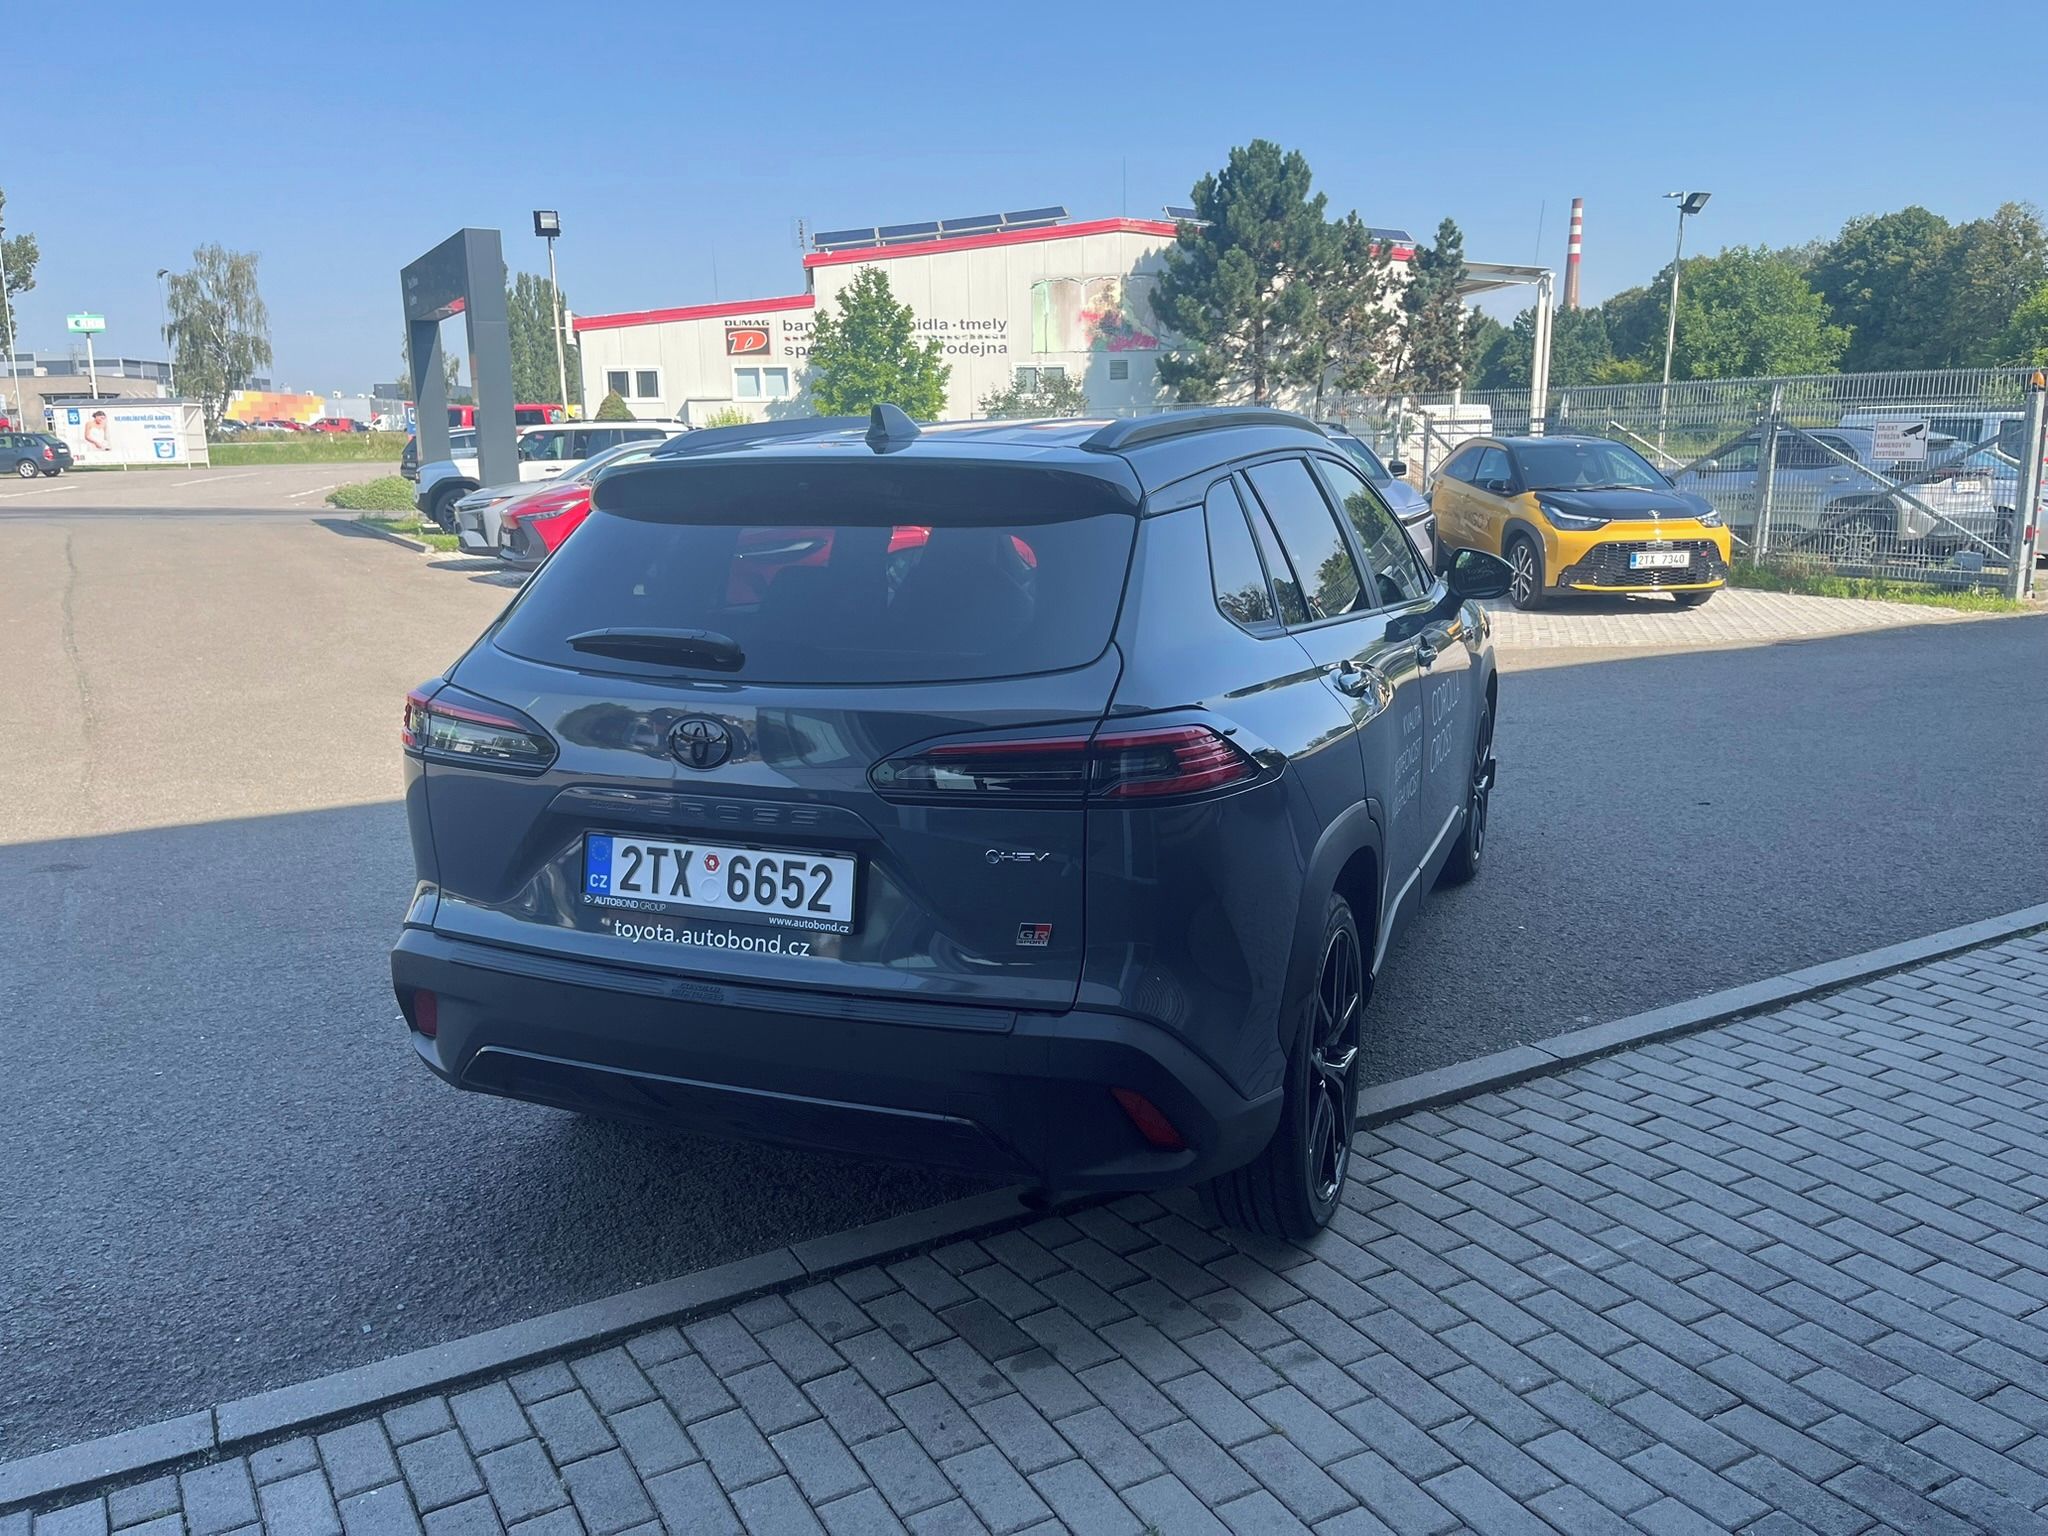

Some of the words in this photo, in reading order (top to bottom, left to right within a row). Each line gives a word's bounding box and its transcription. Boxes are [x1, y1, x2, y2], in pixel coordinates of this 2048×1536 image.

[959, 318, 1007, 333] tmely
[589, 873, 608, 888] CZ
[619, 845, 694, 898] 2TX
[726, 855, 833, 913] 6652
[593, 896, 639, 909] AUTOBOND
[639, 901, 667, 911] GROUP
[768, 916, 850, 933] www.autobond.cz
[614, 919, 811, 957] toyota.autobond.cz
[1020, 930, 1049, 940] GR
